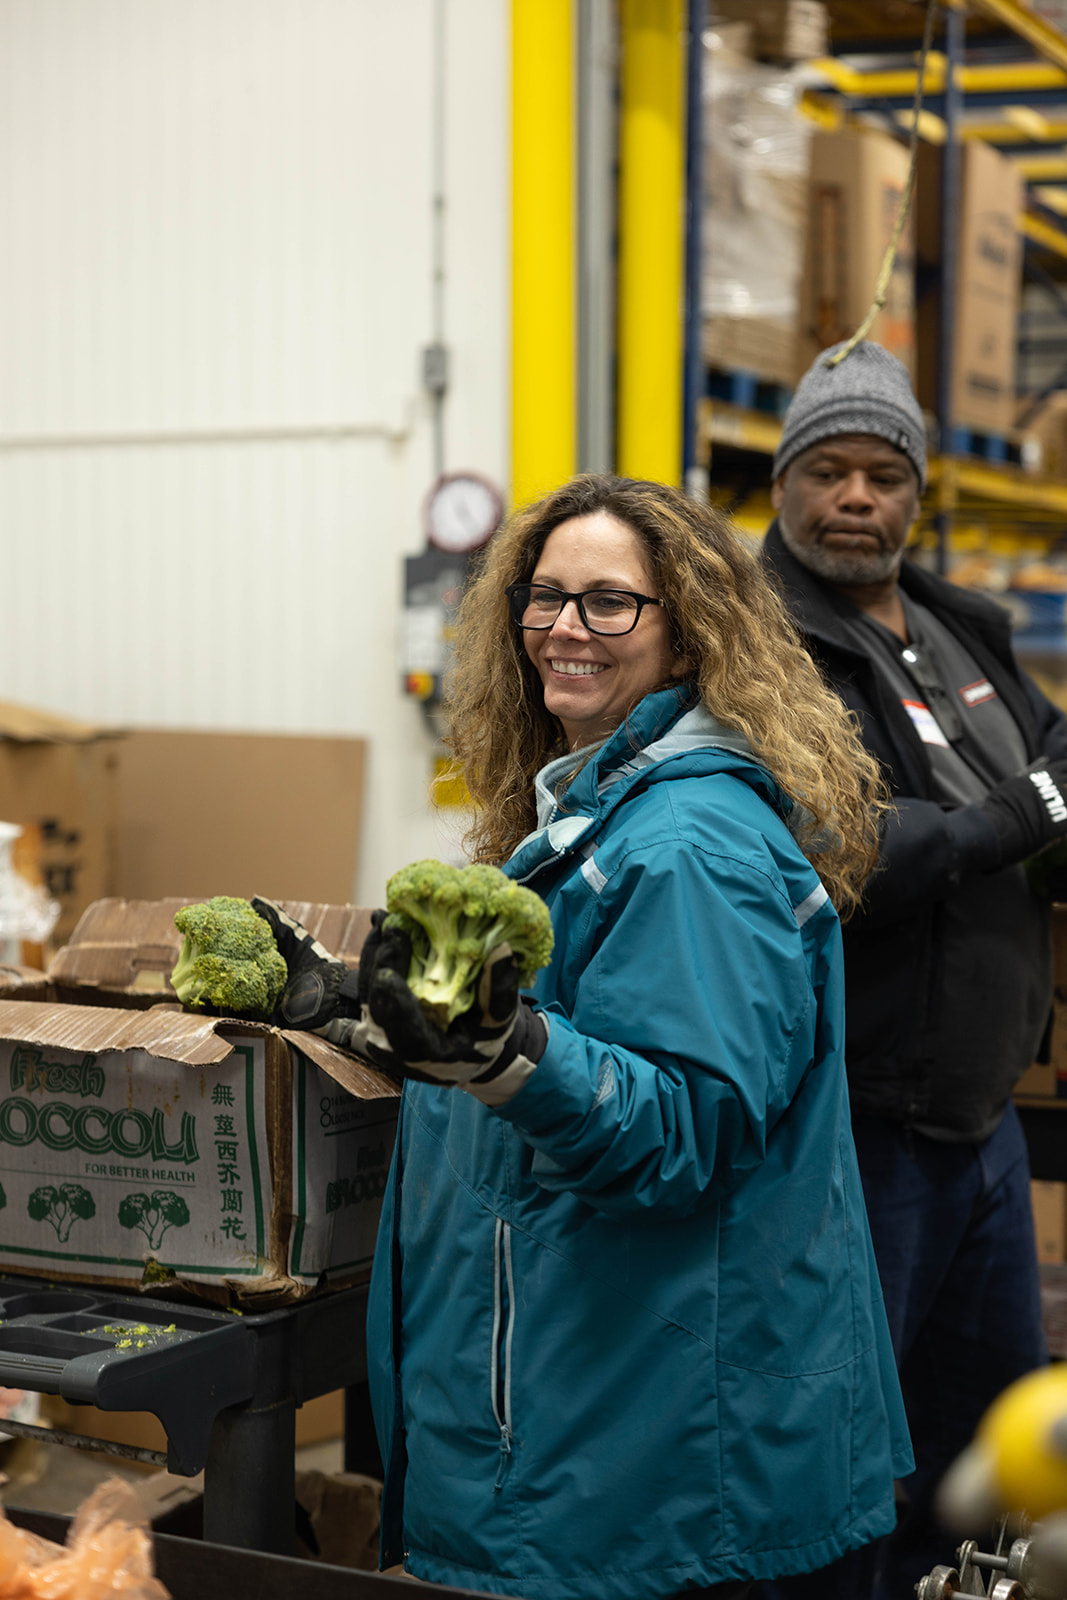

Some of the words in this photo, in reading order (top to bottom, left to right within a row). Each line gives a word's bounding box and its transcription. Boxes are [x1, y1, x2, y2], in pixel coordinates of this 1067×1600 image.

[10, 1046, 105, 1098] Fresh
[85, 1163, 107, 1175] FOR
[109, 1165, 150, 1179] BETTER
[152, 1171, 196, 1183] HEALTH
